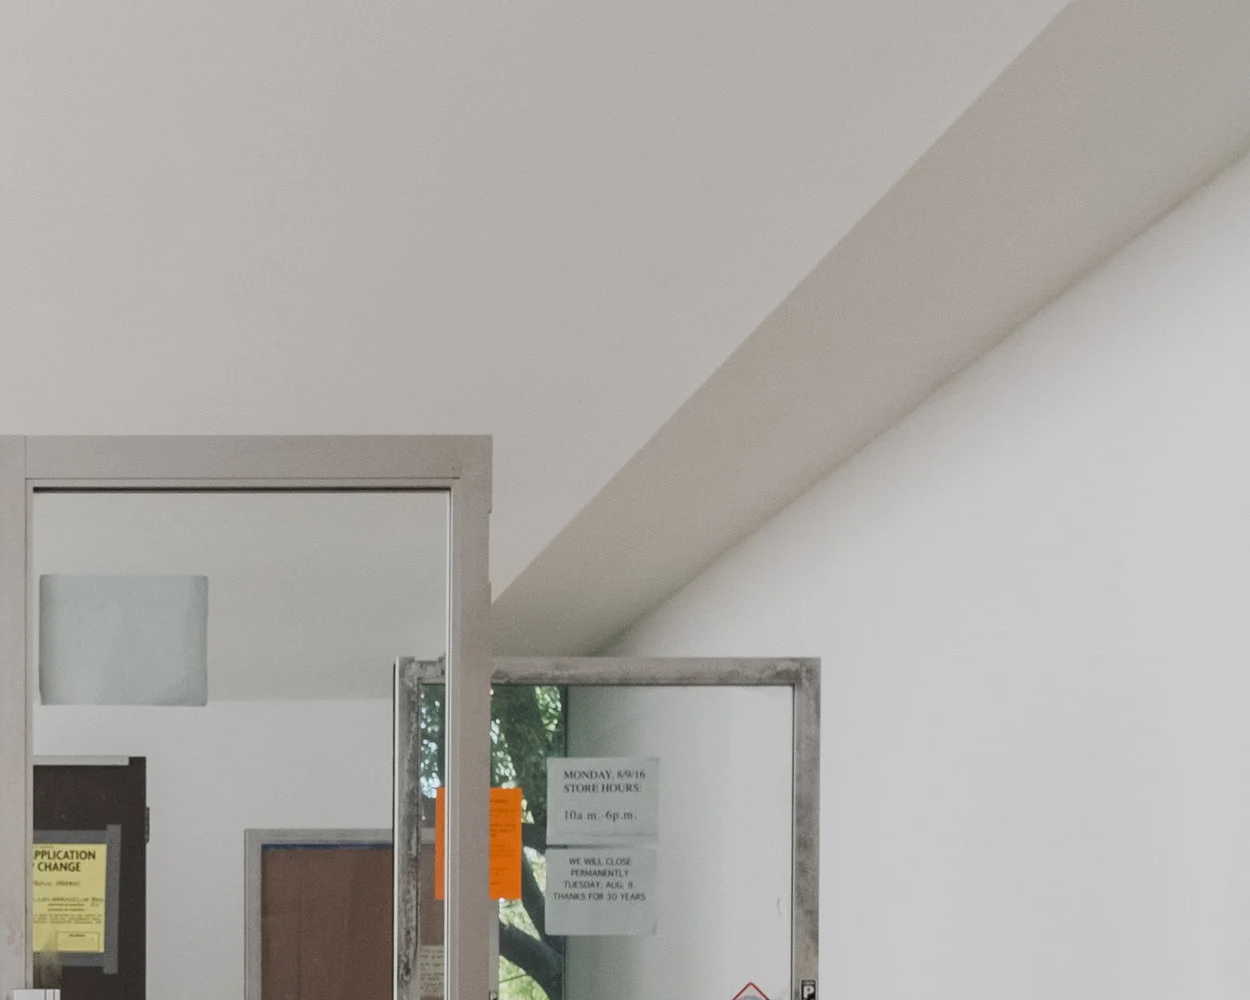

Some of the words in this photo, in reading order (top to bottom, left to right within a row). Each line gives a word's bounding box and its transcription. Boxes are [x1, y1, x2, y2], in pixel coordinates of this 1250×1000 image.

[563, 783, 598, 793] STORE
[33, 850, 96, 860] PPLICATION
[569, 858, 581, 866] WE
[584, 858, 603, 866] WILL
[605, 858, 632, 866] CLOSE
[37, 862, 81, 872] CHANGE
[570, 869, 629, 878] PERMANENTLY
[553, 892, 586, 901] THANKS
[588, 892, 604, 901] FOR
[607, 892, 618, 901] 30
[620, 892, 647, 901] YEARS
